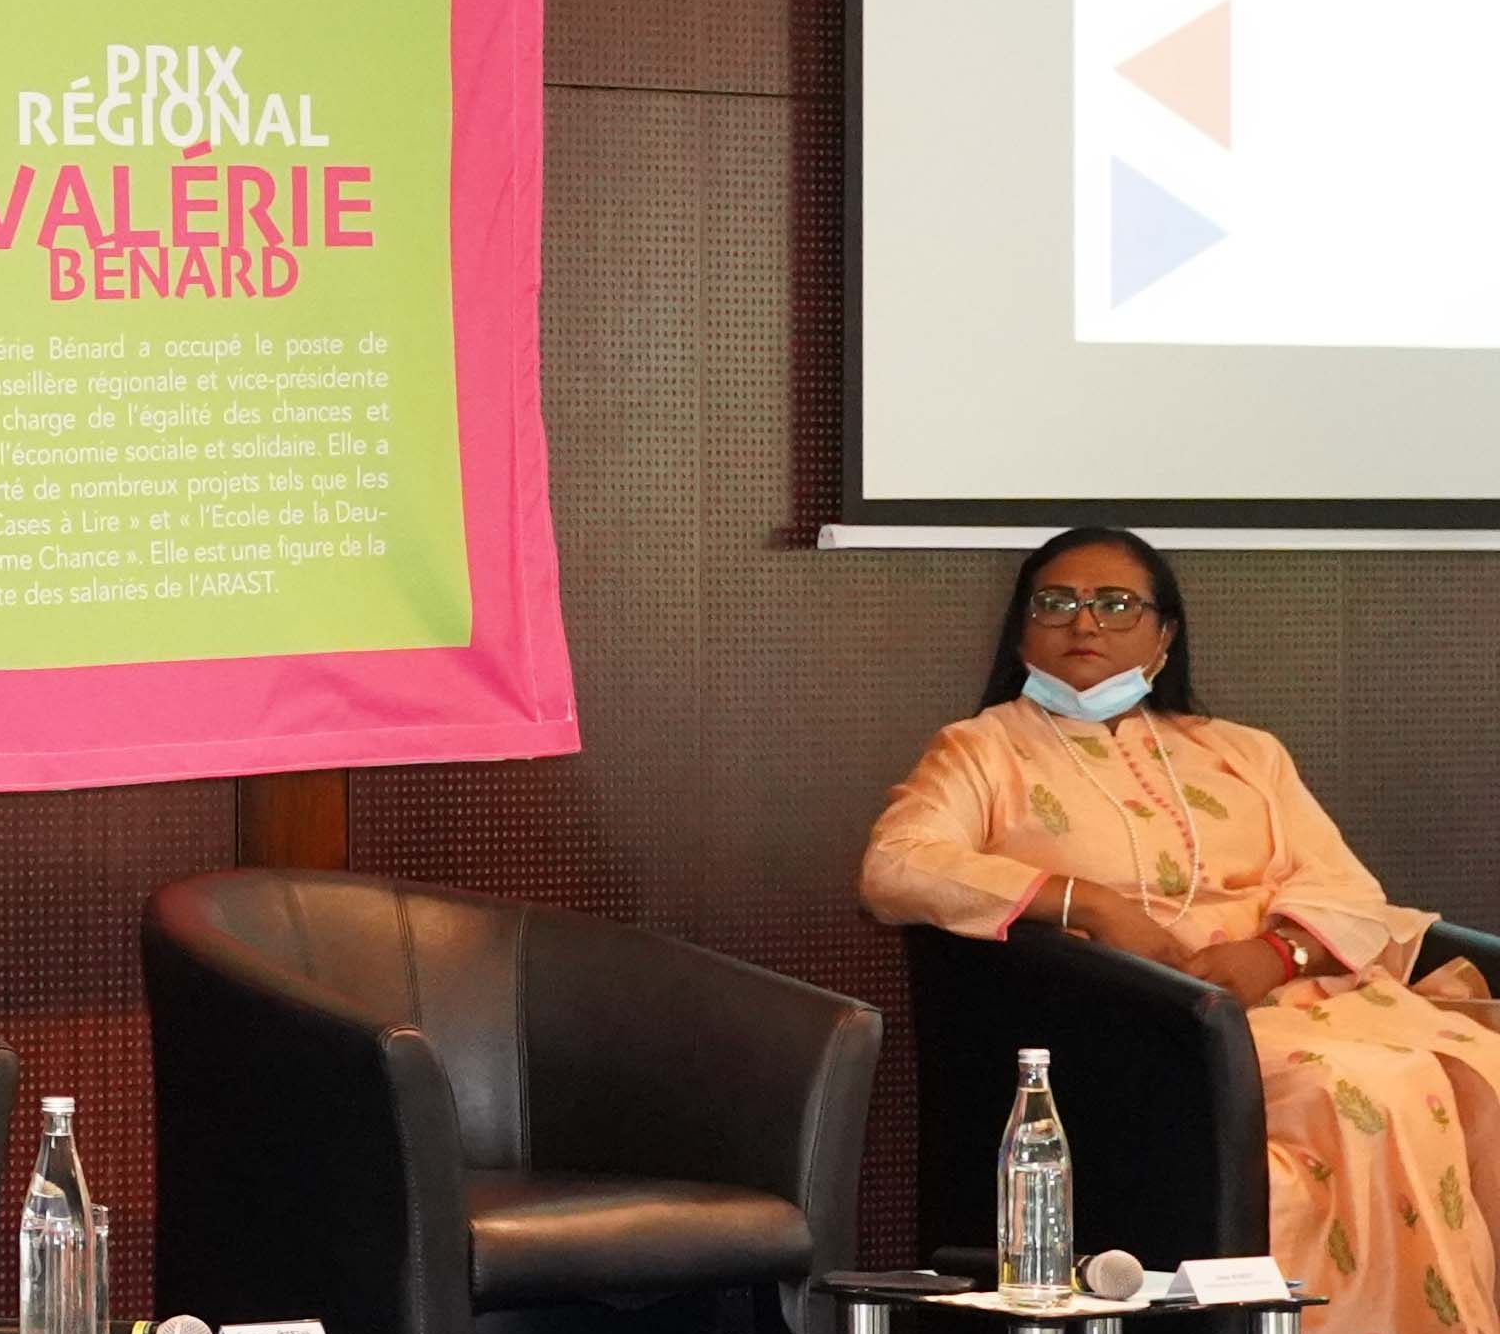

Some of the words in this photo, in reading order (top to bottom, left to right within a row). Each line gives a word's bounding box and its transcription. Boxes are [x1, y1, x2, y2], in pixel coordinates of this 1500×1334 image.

[105, 45, 244, 101] PRIX
[17, 76, 329, 147] RÉGIONAL
[49, 335, 124, 359] Bénard
[139, 341, 151, 357] a
[165, 334, 242, 363] occupé
[256, 332, 273, 355] le
[286, 336, 343, 362] poste
[359, 331, 388, 354] de
[88, 369, 187, 399] régionale
[197, 372, 217, 391] et
[228, 367, 388, 394] vice-présidente
[3, 408, 76, 436] charge
[88, 405, 115, 428] de
[129, 405, 210, 432] l'égalité
[224, 401, 260, 424] des
[273, 402, 352, 422] chances
[367, 403, 390, 422] et
[0, 443, 118, 465] l'économie
[126, 443, 198, 461] sociale
[204, 440, 225, 459] et
[232, 435, 321, 458] solidaire.
[329, 433, 367, 456] Elle
[376, 439, 388, 455] a
[34, 478, 60, 500] de
[71, 475, 177, 498] nombreux
[188, 475, 260, 501] projets
[269, 469, 303, 491] tels
[312, 475, 346, 496] que
[357, 467, 388, 488] les
[59, 512, 72, 533] à
[82, 512, 119, 532] Lire
[150, 511, 170, 530] et
[201, 505, 270, 527] l'Ecole
[279, 502, 304, 524] de
[314, 502, 328, 523] la
[336, 501, 387, 522] Deu-
[39, 546, 120, 570] Chance
[151, 539, 188, 564] Elle
[194, 544, 226, 561] est
[232, 544, 271, 560] une
[278, 539, 333, 565] figure
[340, 539, 362, 556] de
[368, 534, 387, 555] la
[24, 582, 63, 605] des
[70, 579, 148, 603] salariés
[155, 576, 182, 598] de
[190, 571, 279, 596] l'ARAST.
